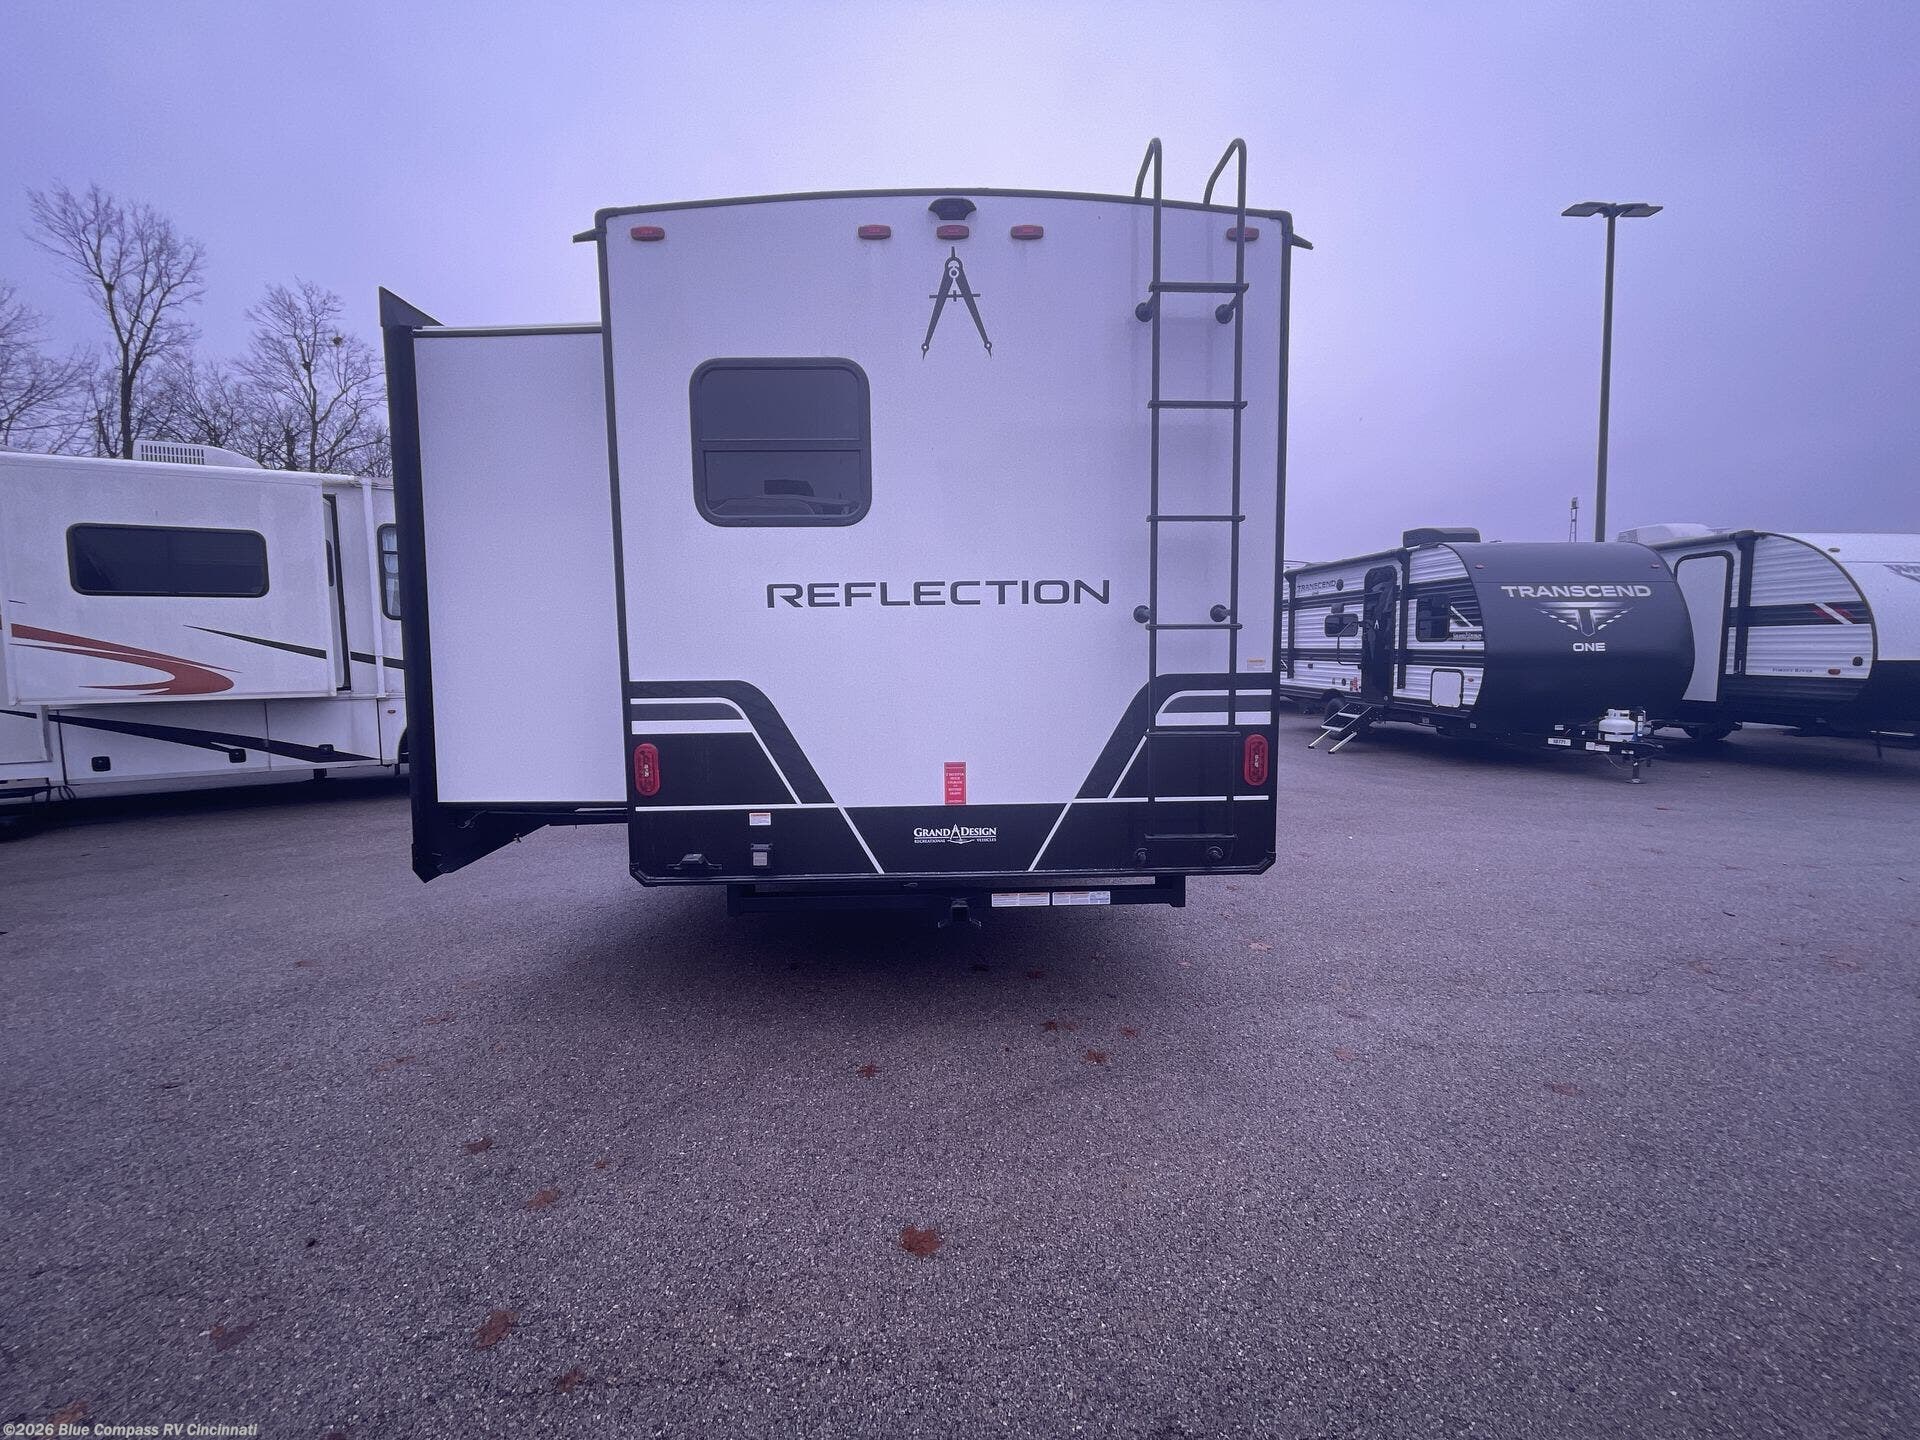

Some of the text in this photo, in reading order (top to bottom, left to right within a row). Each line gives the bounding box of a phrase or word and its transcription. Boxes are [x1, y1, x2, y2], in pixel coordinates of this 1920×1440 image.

[767, 580, 1110, 608] REFLECTION
[1500, 585, 1652, 598] TRANSCEND
[1573, 642, 1606, 652] ONE
[913, 826, 997, 837] GRAND DESIGN
